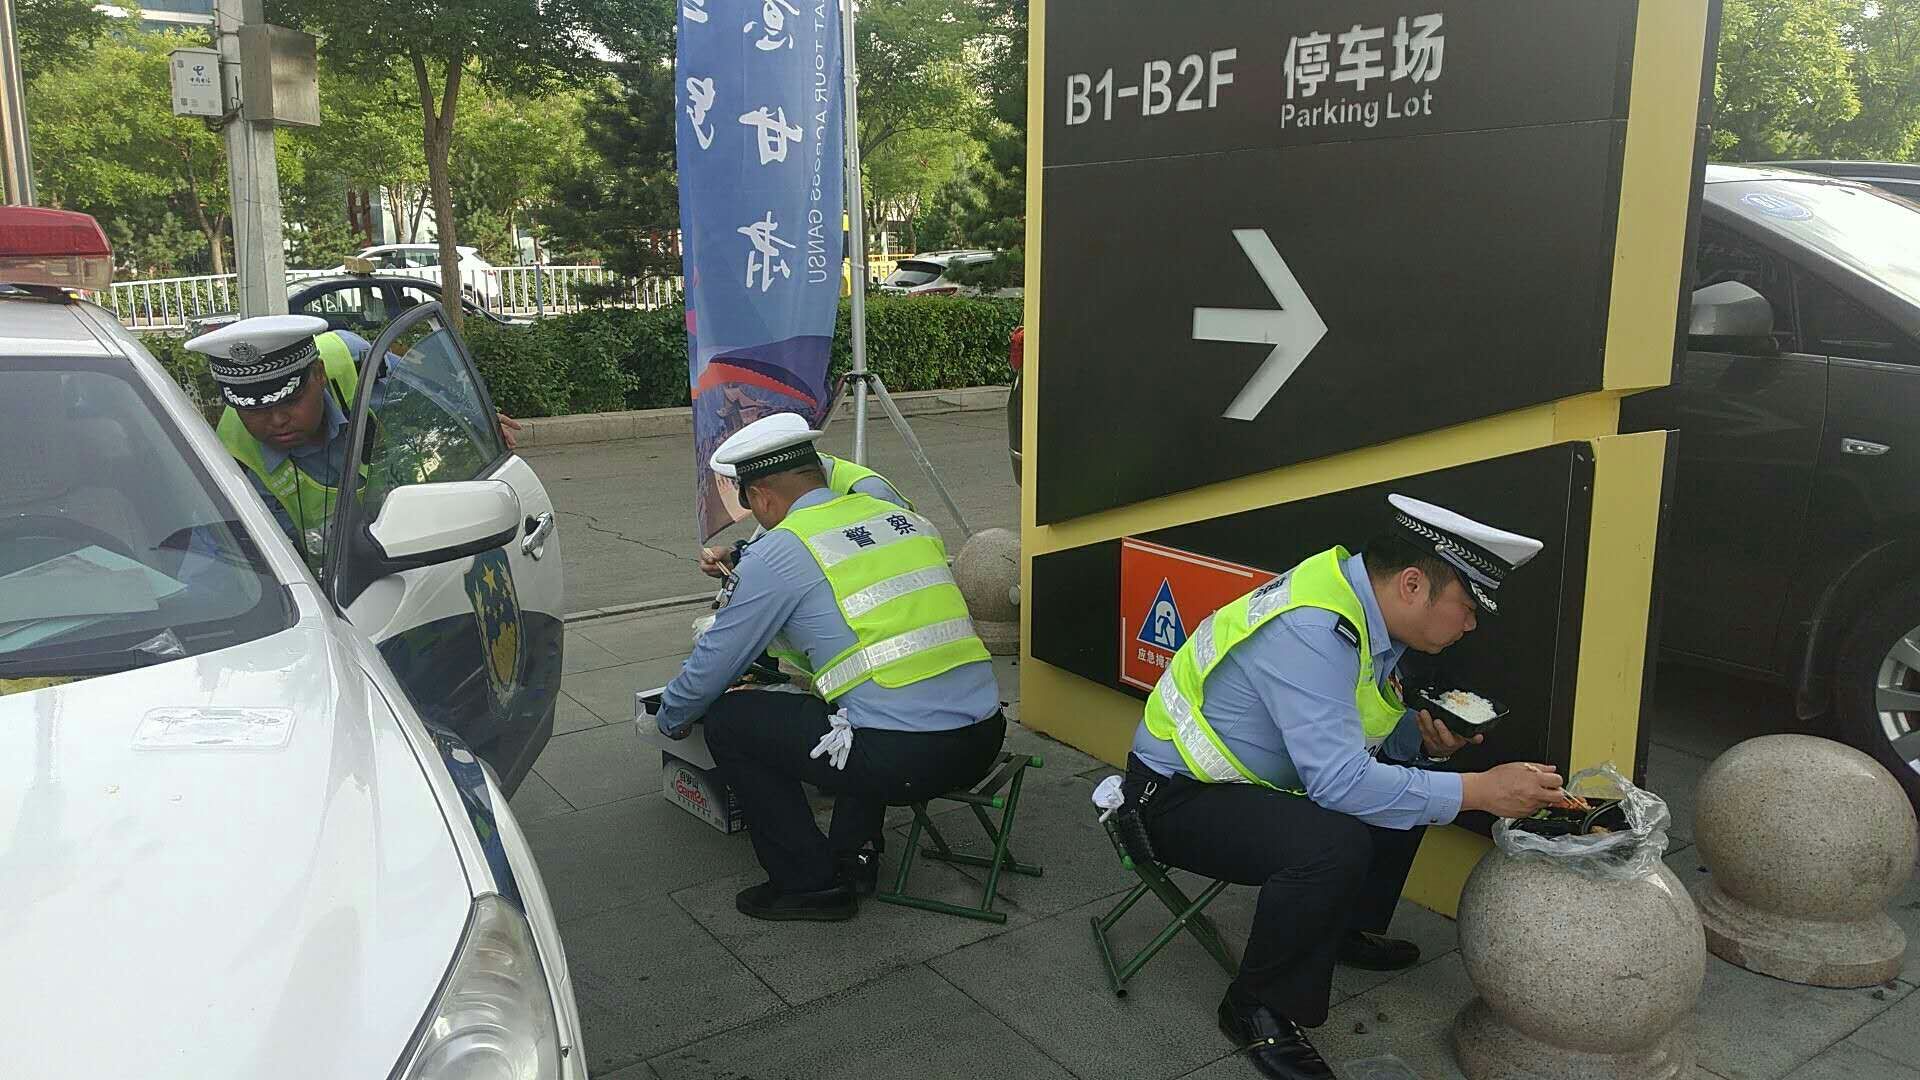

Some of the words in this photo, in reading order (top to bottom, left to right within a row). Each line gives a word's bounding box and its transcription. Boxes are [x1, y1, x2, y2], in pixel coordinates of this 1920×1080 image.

[1283, 13, 1445, 99] 停车场
[1066, 48, 1237, 126] B1-B2F
[1280, 97, 1379, 129] Parking
[1386, 88, 1433, 119] Lot
[842, 514, 917, 548] 警察
